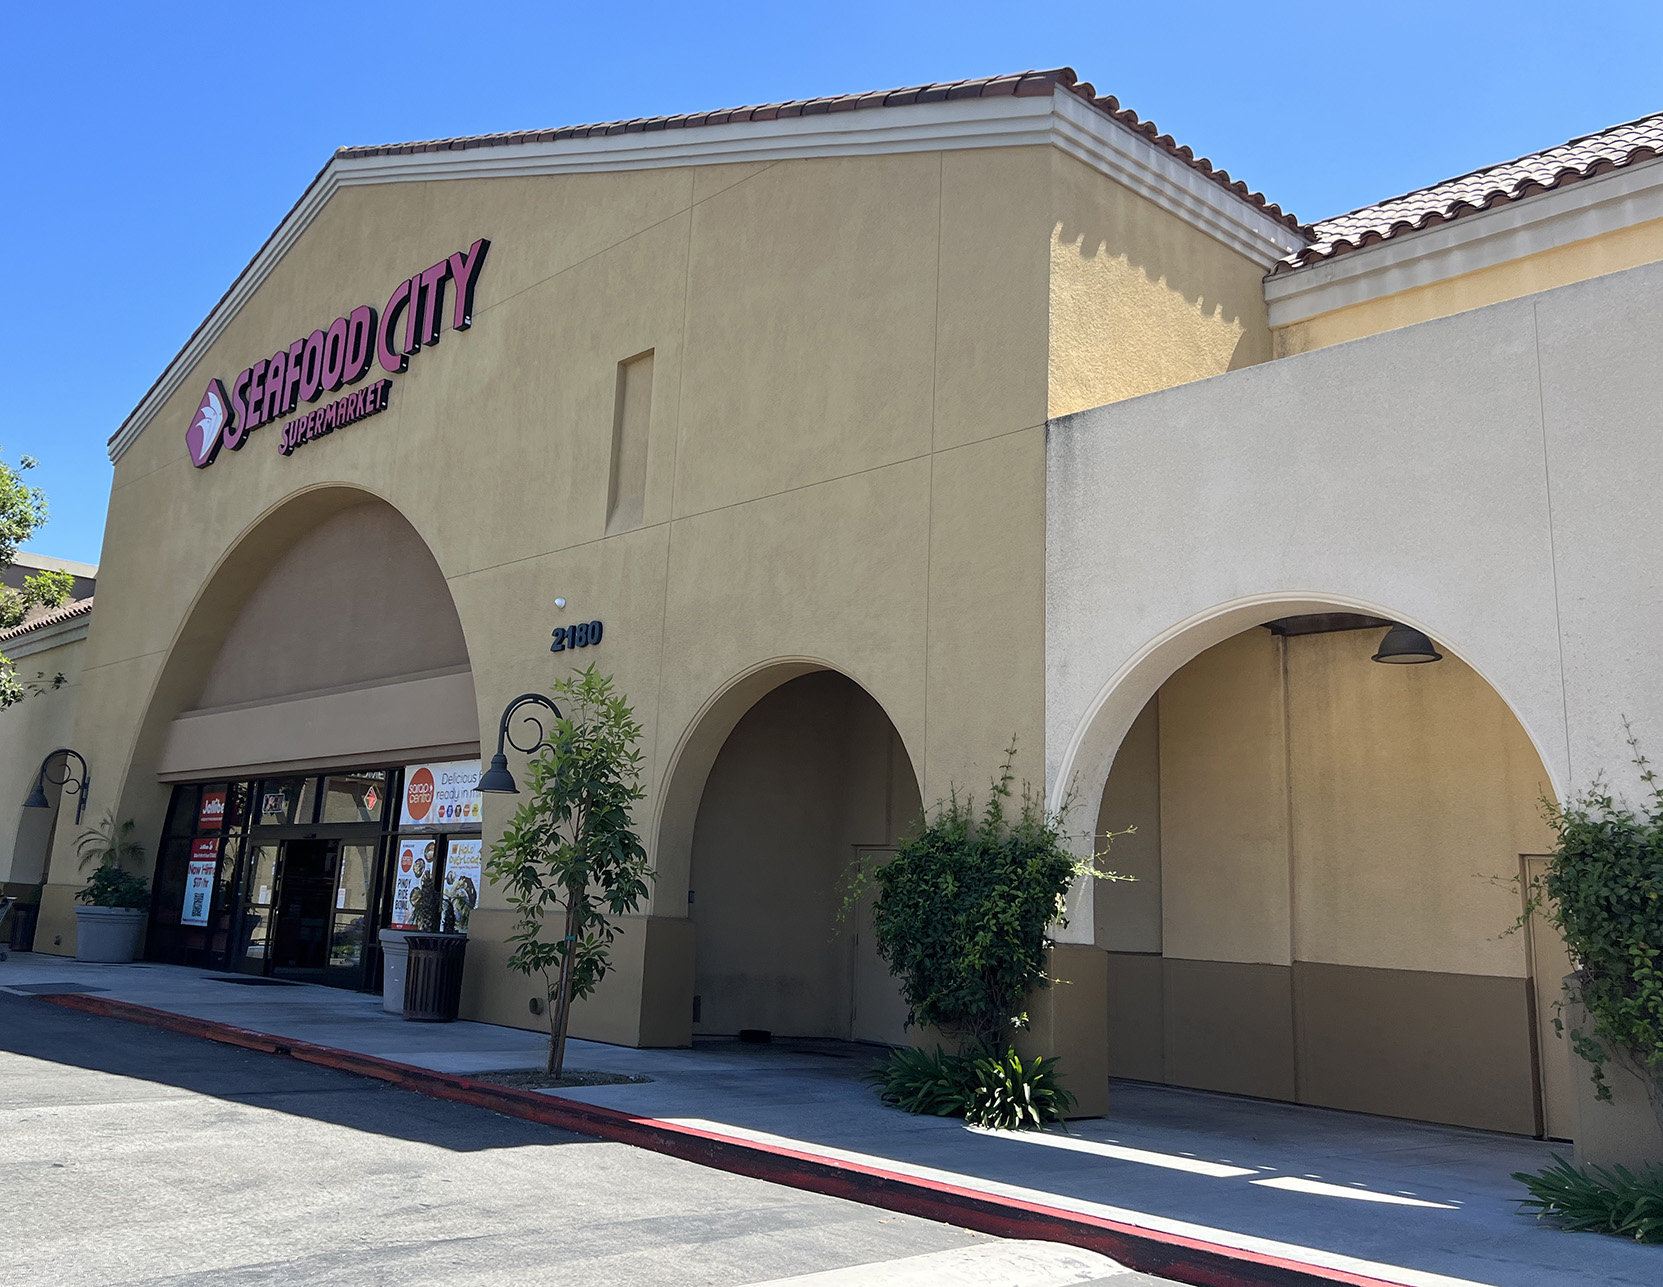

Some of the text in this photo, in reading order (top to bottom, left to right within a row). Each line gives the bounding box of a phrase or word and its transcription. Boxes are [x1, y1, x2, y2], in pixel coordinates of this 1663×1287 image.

[223, 238, 491, 451] SEAFOOD CITY
[278, 379, 392, 456] SUPERMARKET
[550, 620, 603, 652] 2180
[441, 772, 478, 785] Delicious
[409, 792, 432, 804] central
[436, 787, 460, 802] ready
[461, 787, 468, 799] in
[203, 798, 225, 815] Jollibe
[188, 864, 201, 875] Now
[397, 878, 412, 889] PINOY
[398, 889, 409, 900] RICE
[395, 899, 409, 910] BOWL
